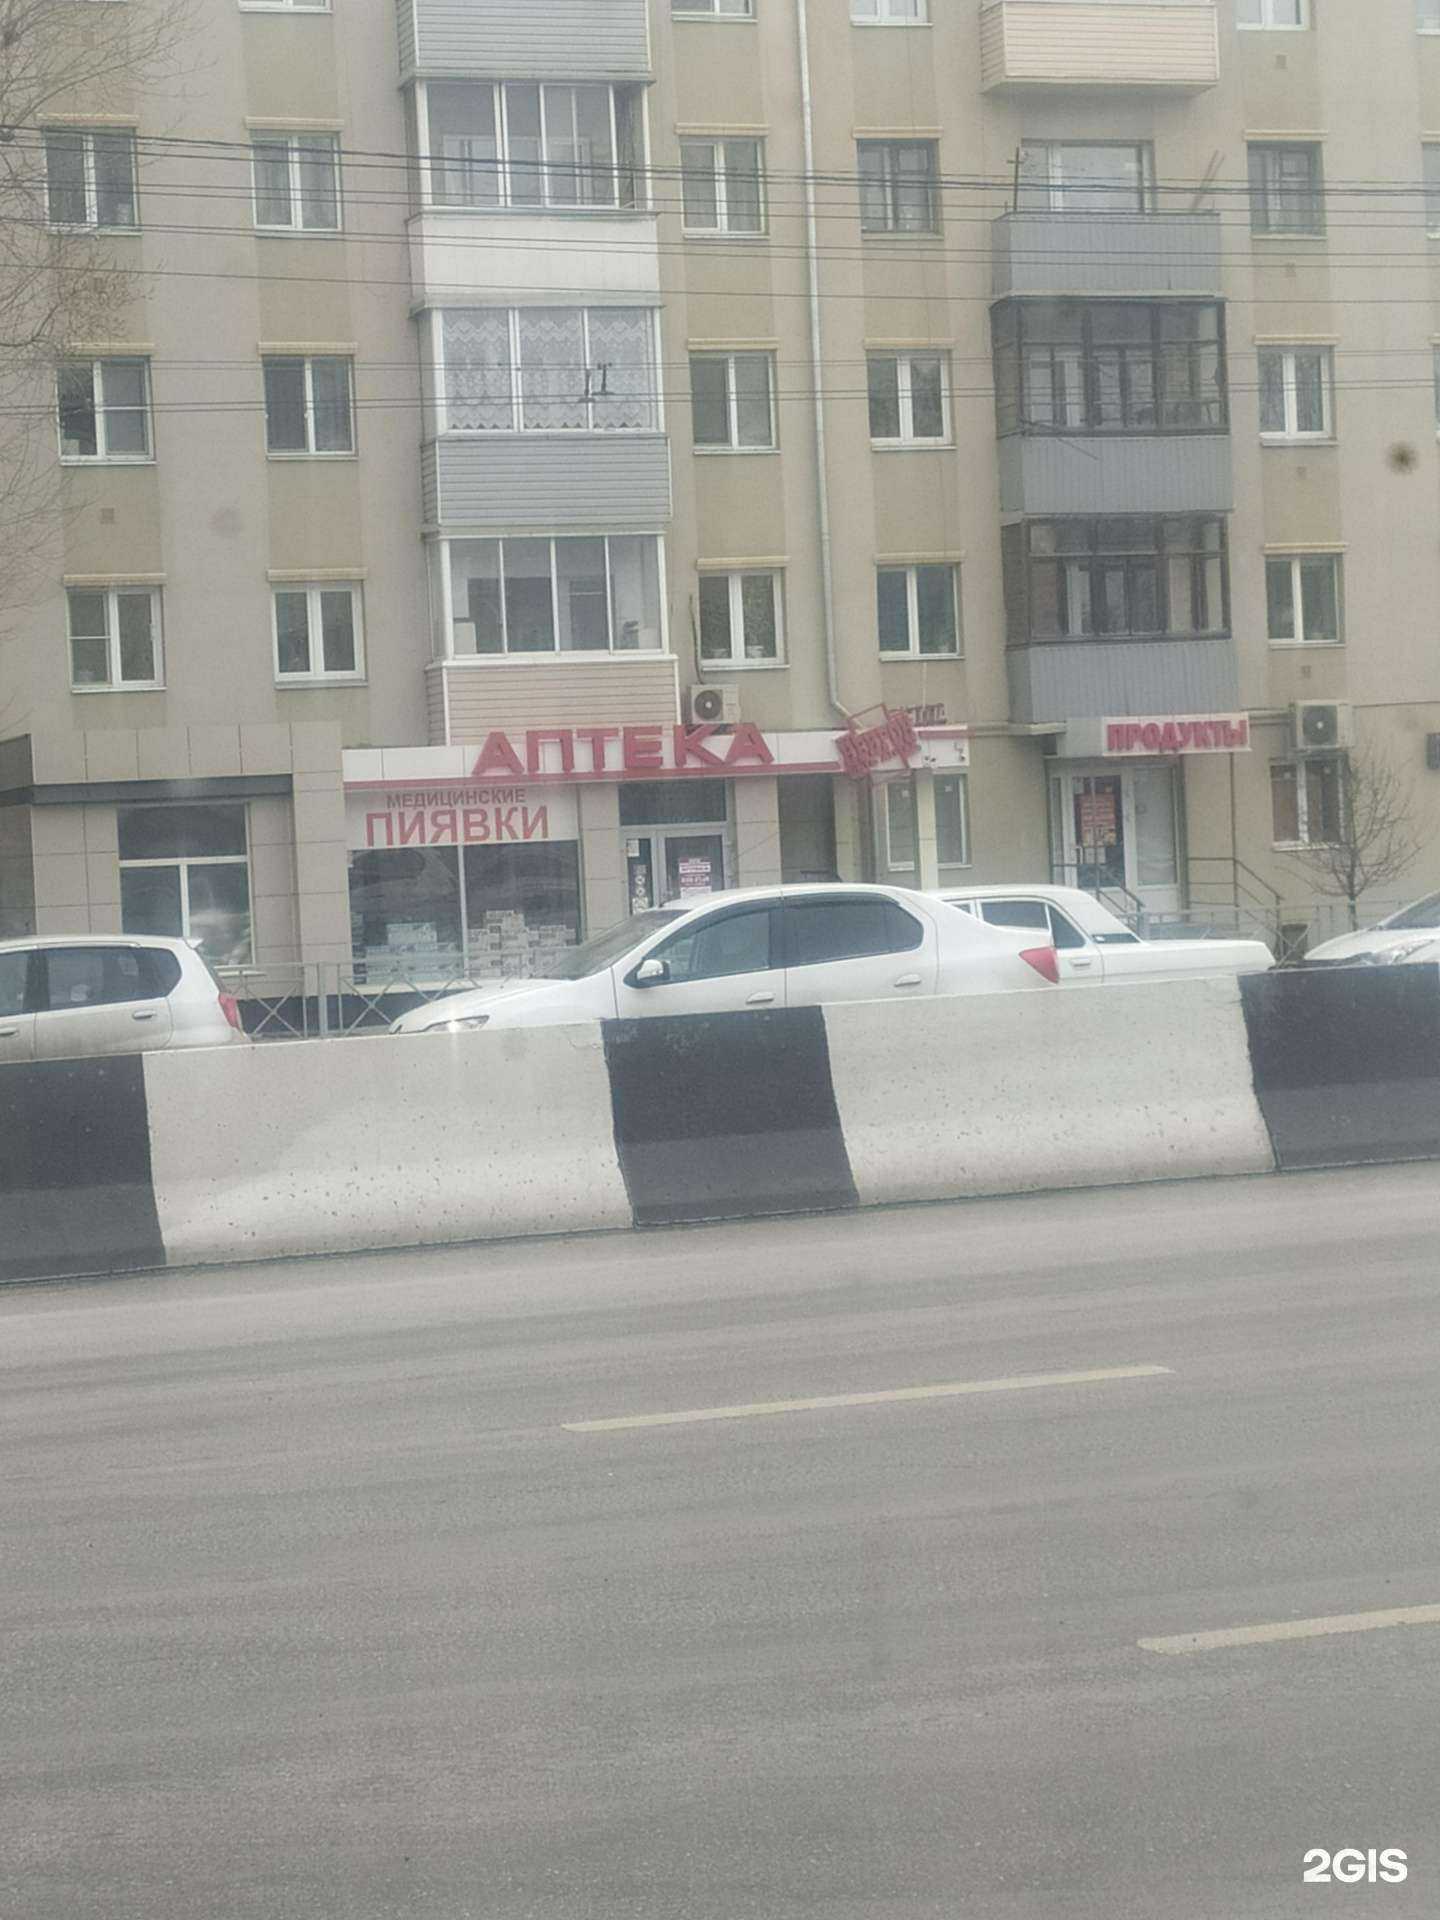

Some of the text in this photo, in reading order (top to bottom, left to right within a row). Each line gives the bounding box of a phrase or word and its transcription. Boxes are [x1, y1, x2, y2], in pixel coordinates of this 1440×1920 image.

[472, 723, 775, 775] АПТЕКА
[1107, 720, 1247, 752] ПРОДУКТЫ
[386, 788, 526, 809] МЕДИЦИНСКИЕ
[365, 806, 549, 847] ПИЯВКИ
